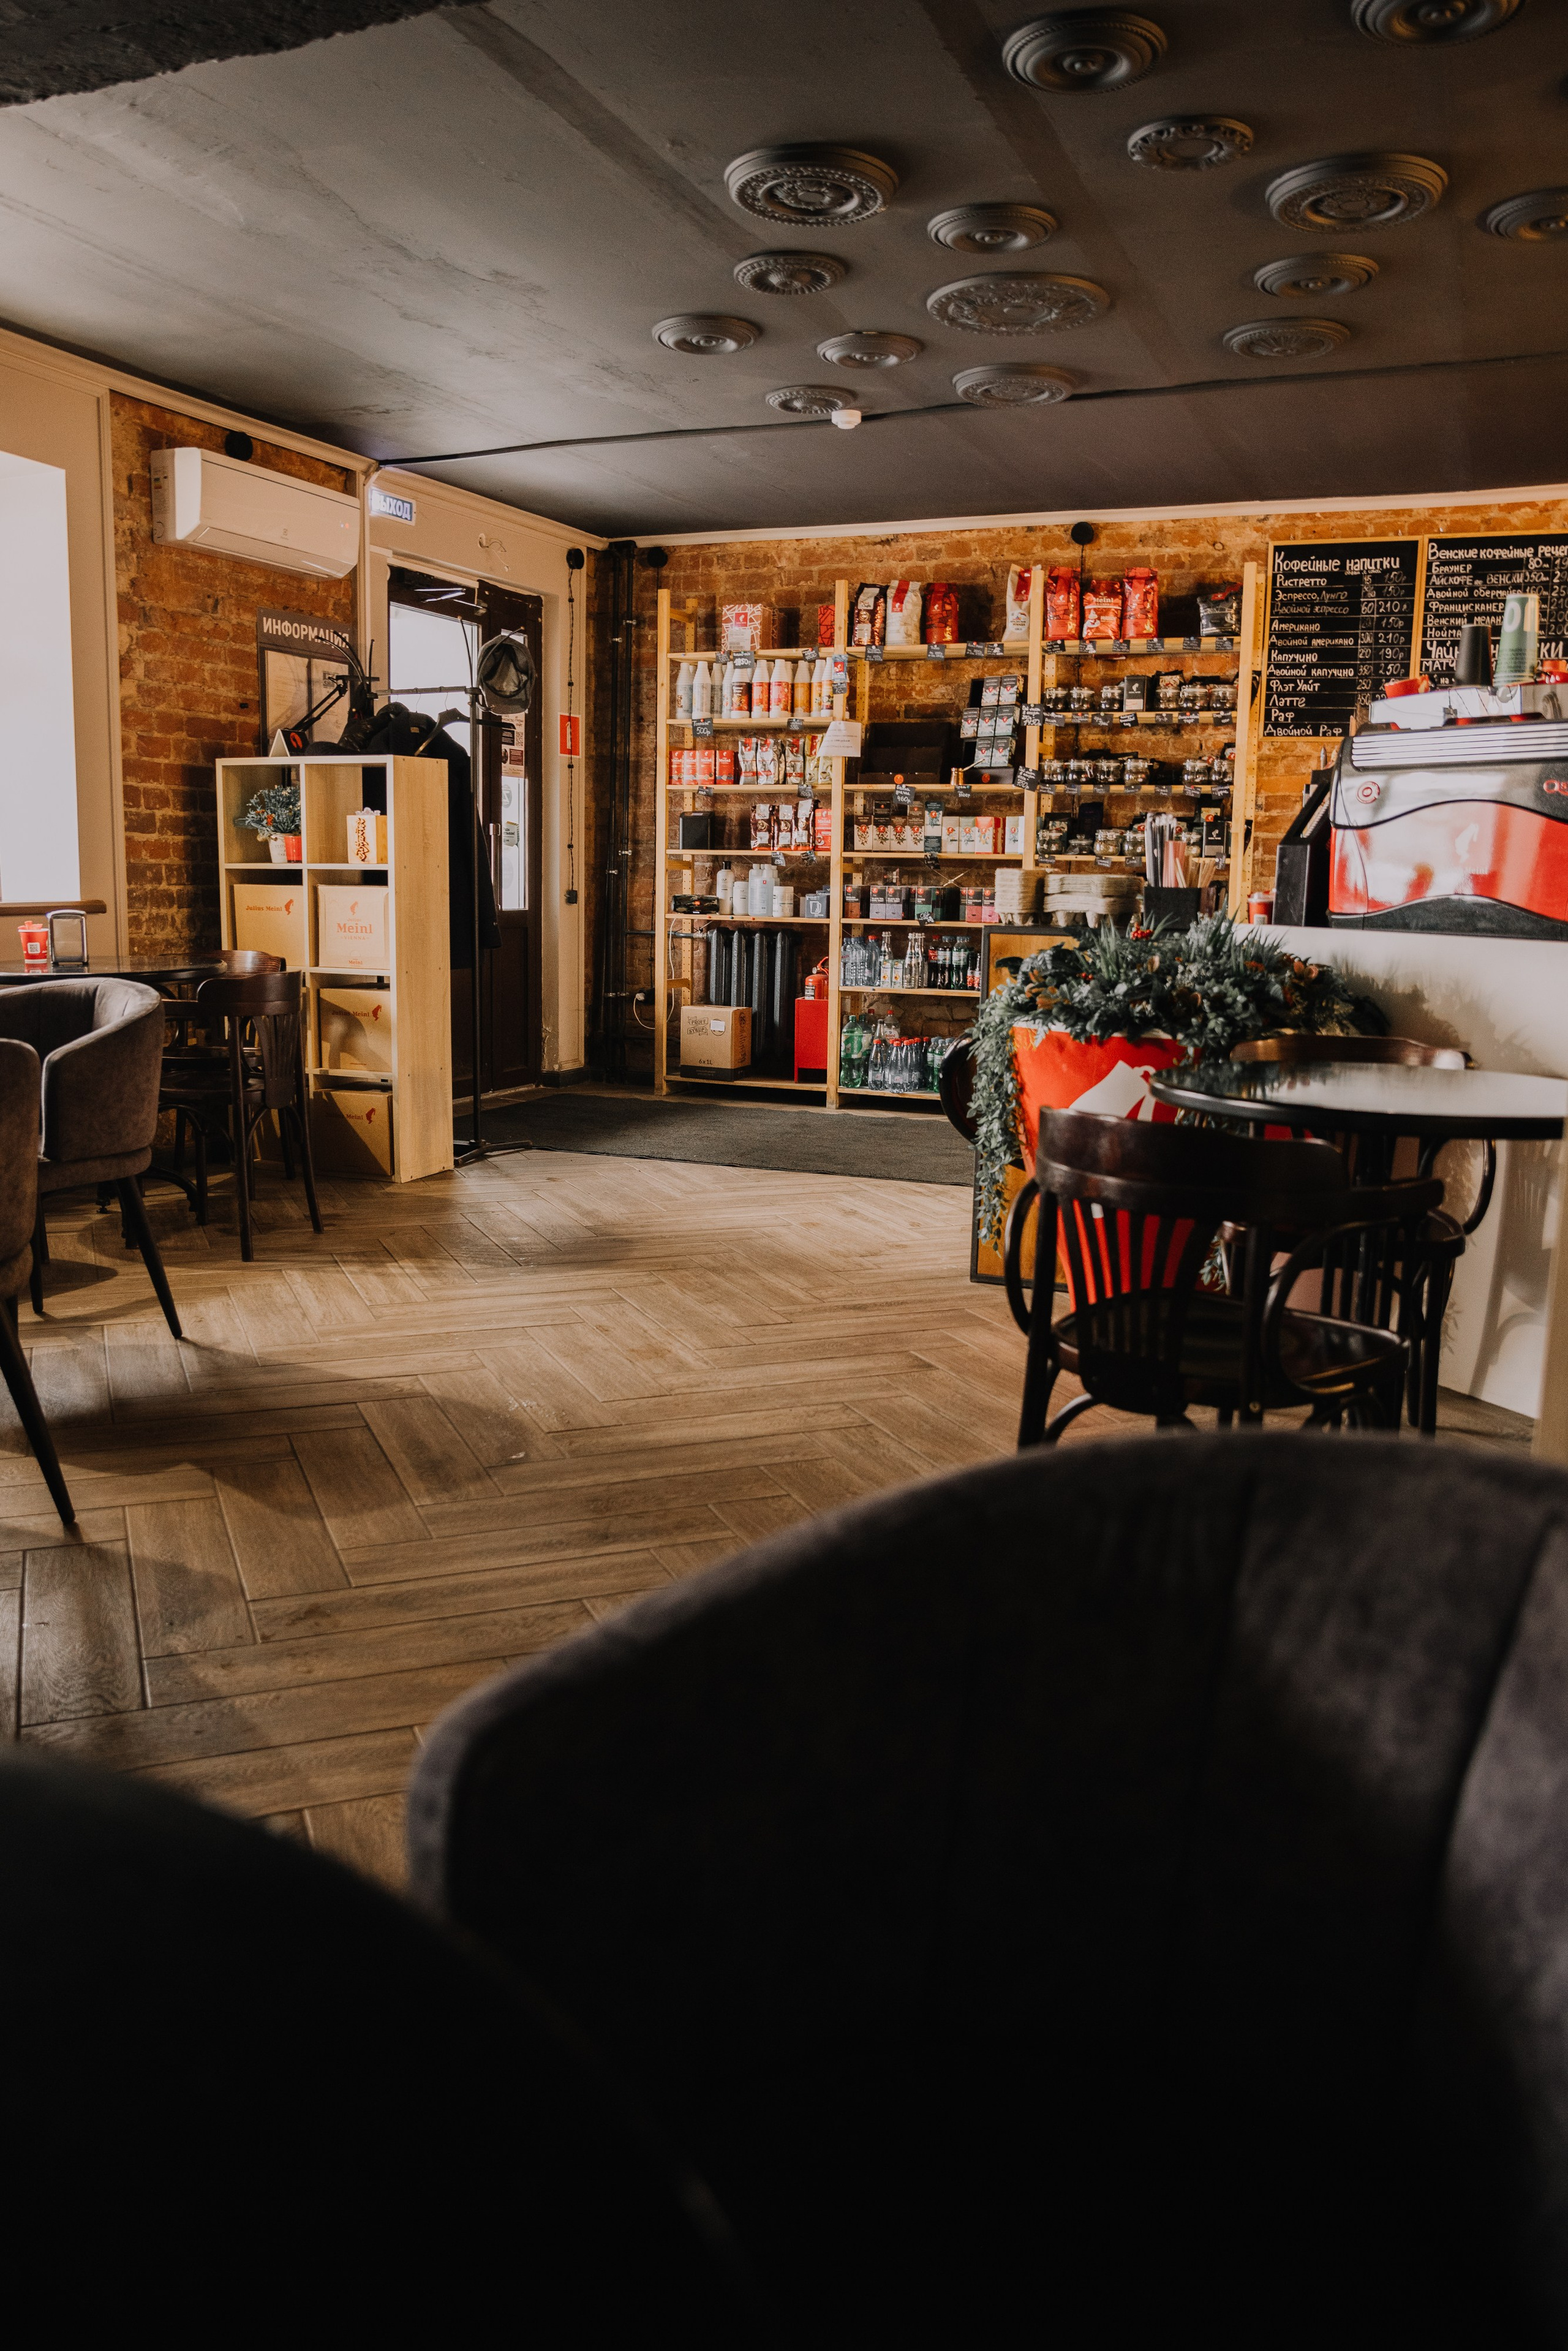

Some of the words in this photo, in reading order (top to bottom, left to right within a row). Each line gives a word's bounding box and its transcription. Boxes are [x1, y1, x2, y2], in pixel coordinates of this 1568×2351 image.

[372, 490, 411, 520] ВЫХОД
[1428, 543, 1478, 560] Венские
[1480, 546, 1534, 559] кофейные
[1275, 551, 1340, 572] Кофейные
[1346, 557, 1400, 571] напитки
[1277, 574, 1327, 587] Ристретто
[1427, 587, 1469, 598] Двойной
[1361, 602, 1374, 614] 60
[1427, 613, 1468, 626] Венский
[263, 617, 349, 649] ИНФОРМАЦИЯ
[1268, 635, 1308, 647] Двойной
[1267, 664, 1306, 676] Двойной
[1270, 680, 1295, 692] Флэт
[1297, 679, 1321, 692] Уайт
[1269, 694, 1306, 707] Латте
[1272, 709, 1295, 722] Раф
[696, 726, 710, 736] 500р
[1264, 723, 1313, 736] Двойной
[1319, 725, 1342, 736] Раф
[897, 795, 911, 804] 460р
[337, 923, 373, 934] Meinl
